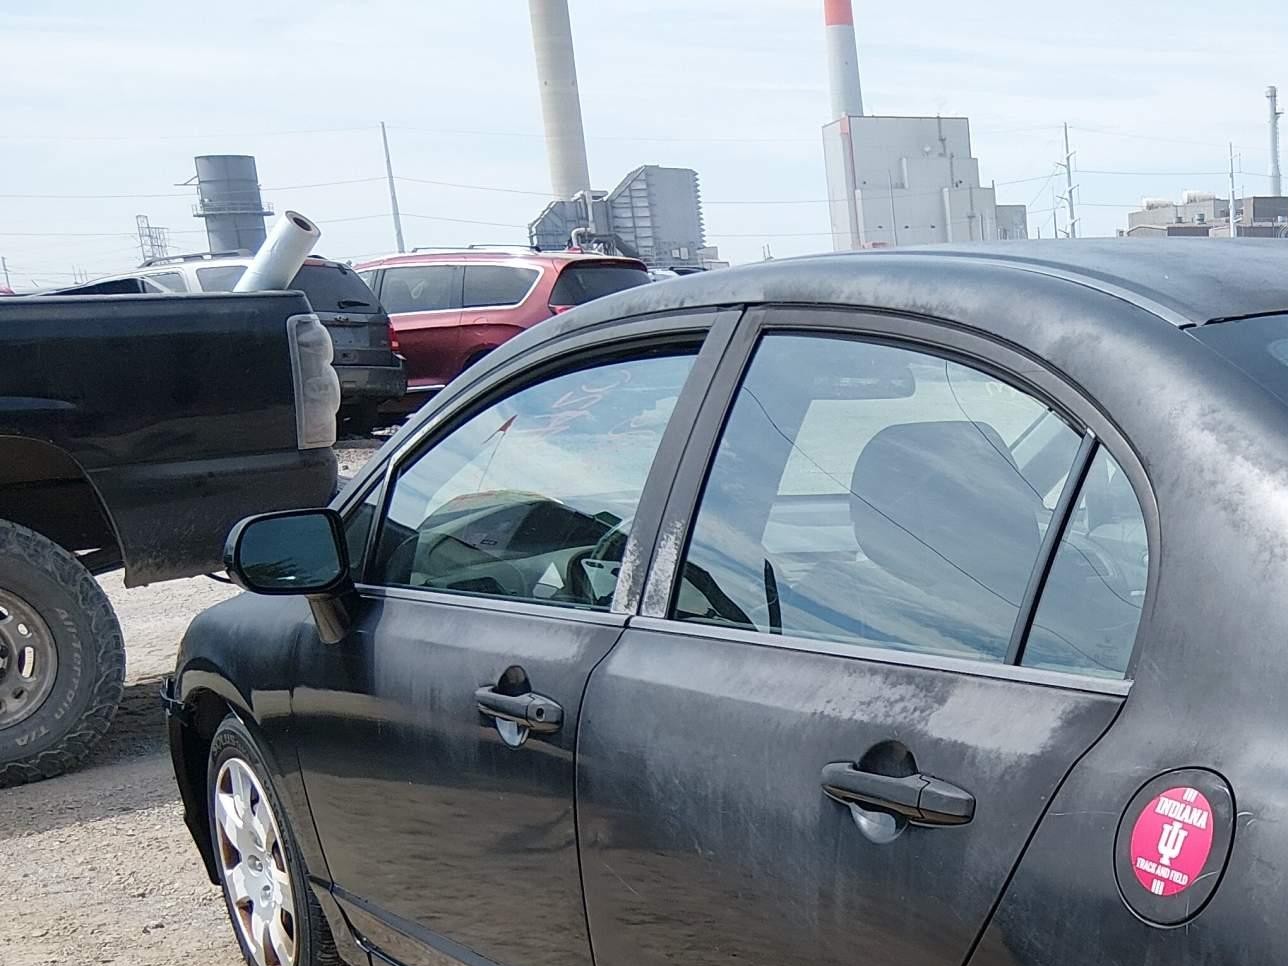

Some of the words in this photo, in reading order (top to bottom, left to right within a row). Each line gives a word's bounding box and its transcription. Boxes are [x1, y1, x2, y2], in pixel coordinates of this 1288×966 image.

[1154, 796, 1209, 830] INDIANA
[1136, 856, 1158, 875] TRACK
[1155, 864, 1171, 880] AND
[1169, 869, 1189, 886] FIELD
